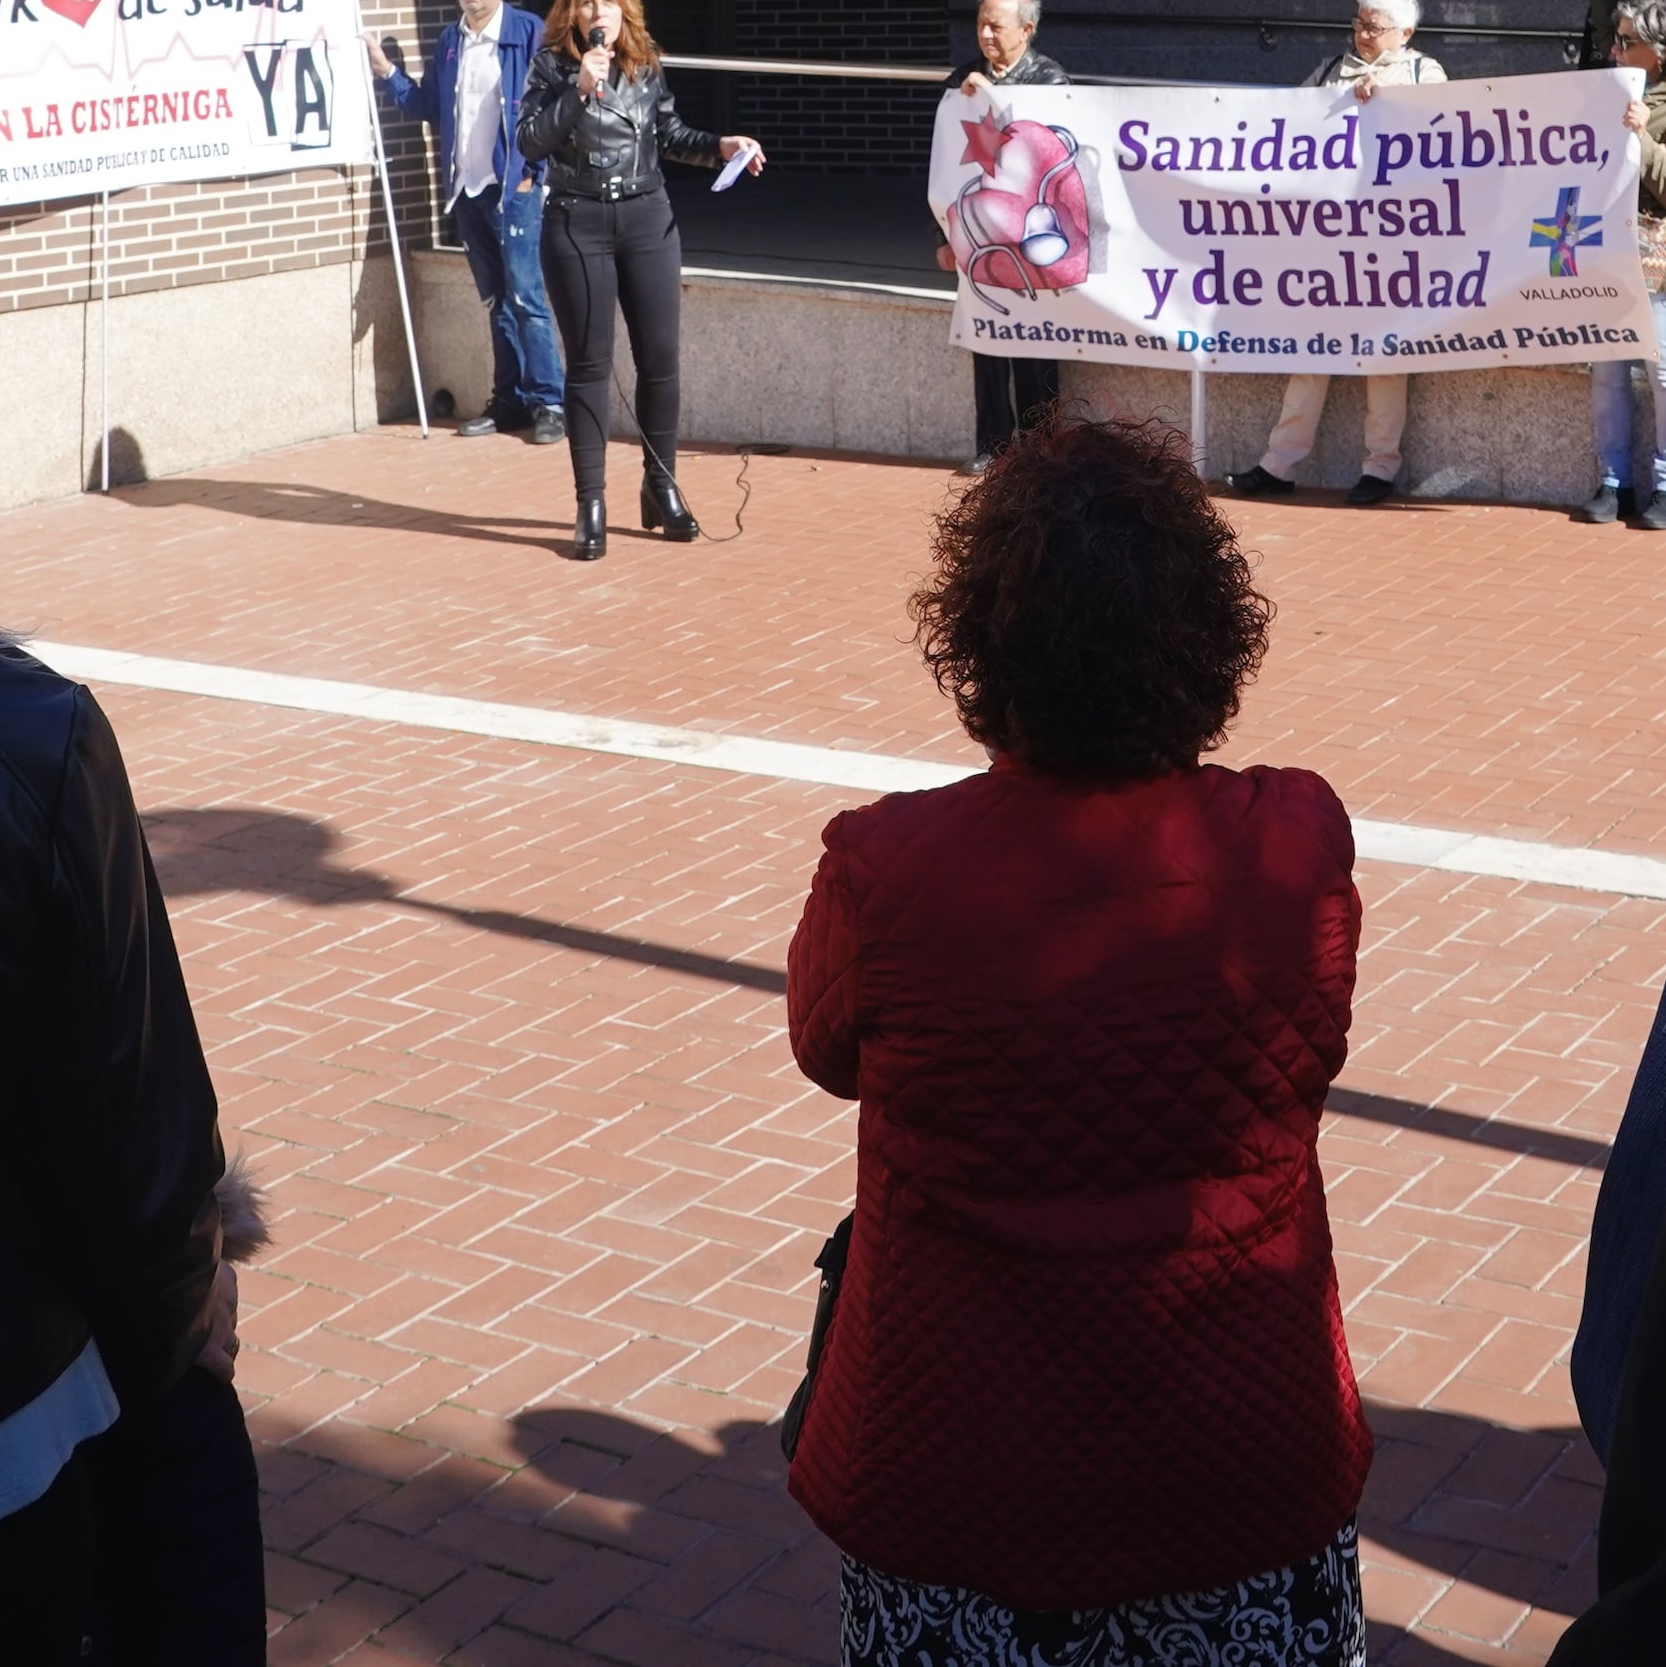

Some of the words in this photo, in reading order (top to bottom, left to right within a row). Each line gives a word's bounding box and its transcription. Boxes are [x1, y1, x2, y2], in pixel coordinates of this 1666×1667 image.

[22, 104, 63, 138] LA
[72, 85, 233, 134] CISTÉRNIGA
[245, 40, 331, 137] YA
[13, 165, 39, 182] UNA
[42, 157, 93, 178] SANIDAD
[150, 148, 165, 163] DE
[170, 142, 230, 161] CALIDAD
[1117, 114, 1357, 173] Sanidad
[1374, 108, 1609, 185] pública,
[1180, 179, 1465, 237] universal
[1143, 266, 1178, 320] y
[1192, 248, 1262, 308] de
[1277, 249, 1491, 308] calidad
[1520, 286, 1619, 301] VALLADOLID
[972, 317, 1128, 347] Plataforma
[1135, 335, 1168, 351] en
[1177, 330, 1298, 355] Defensa
[1307, 333, 1342, 356] de
[1351, 333, 1374, 356] la
[1382, 329, 1508, 356] Sanidad
[1513, 324, 1639, 348] Pública
